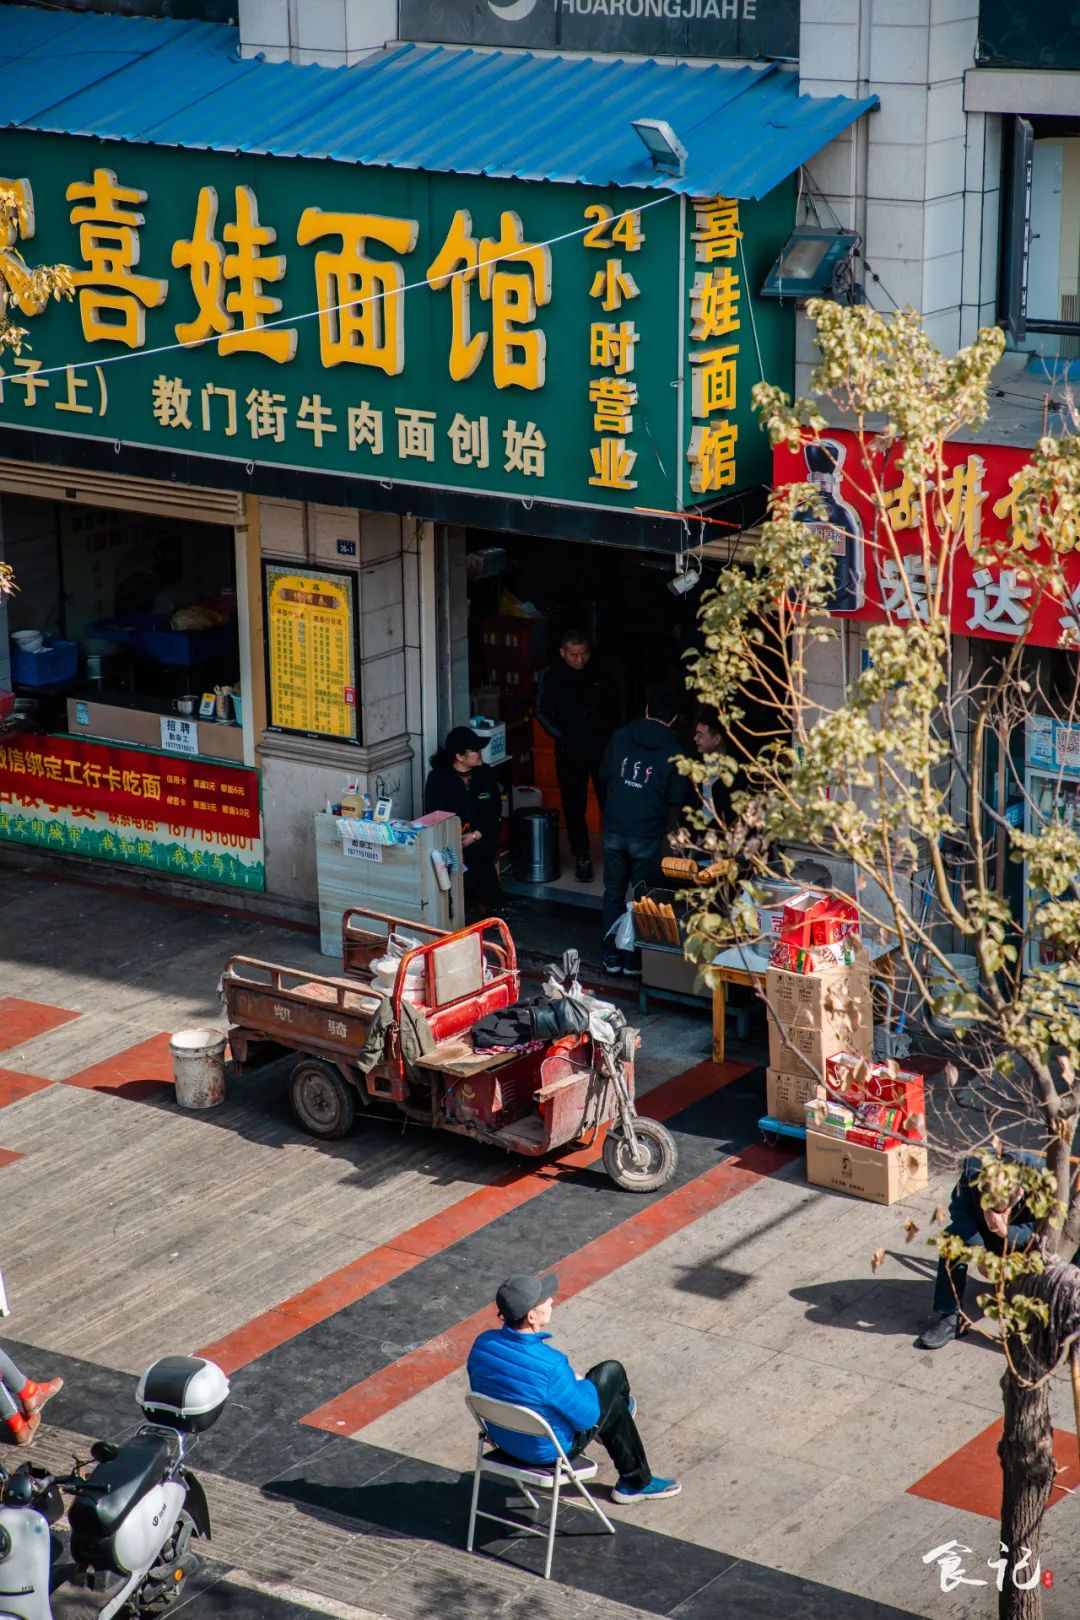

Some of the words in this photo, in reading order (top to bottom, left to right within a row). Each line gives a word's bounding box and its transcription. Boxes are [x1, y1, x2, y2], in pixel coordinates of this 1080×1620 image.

[687, 194, 743, 493] 喜娃面馆
[152, 373, 547, 478] 教门街牛肉面创始
[167, 719, 190, 734] 招聘
